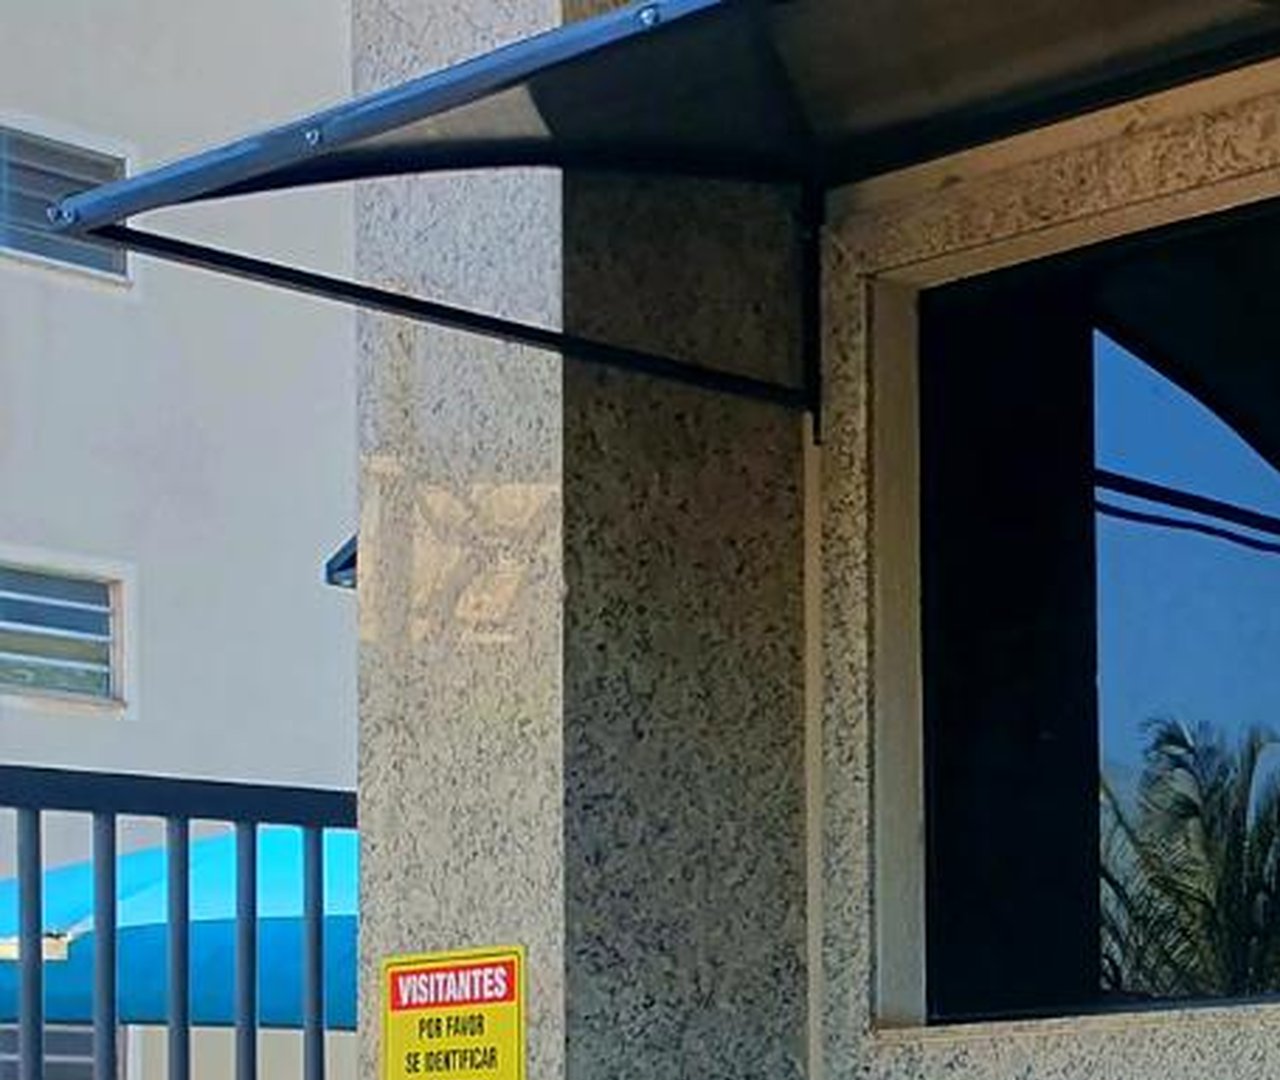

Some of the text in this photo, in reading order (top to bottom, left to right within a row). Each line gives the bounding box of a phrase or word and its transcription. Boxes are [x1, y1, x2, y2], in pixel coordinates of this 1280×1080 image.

[399, 966, 507, 1006] VISITANTES
[418, 1013, 484, 1039] POR FAVOR
[405, 1047, 497, 1073] SE IDENTIFICAR
